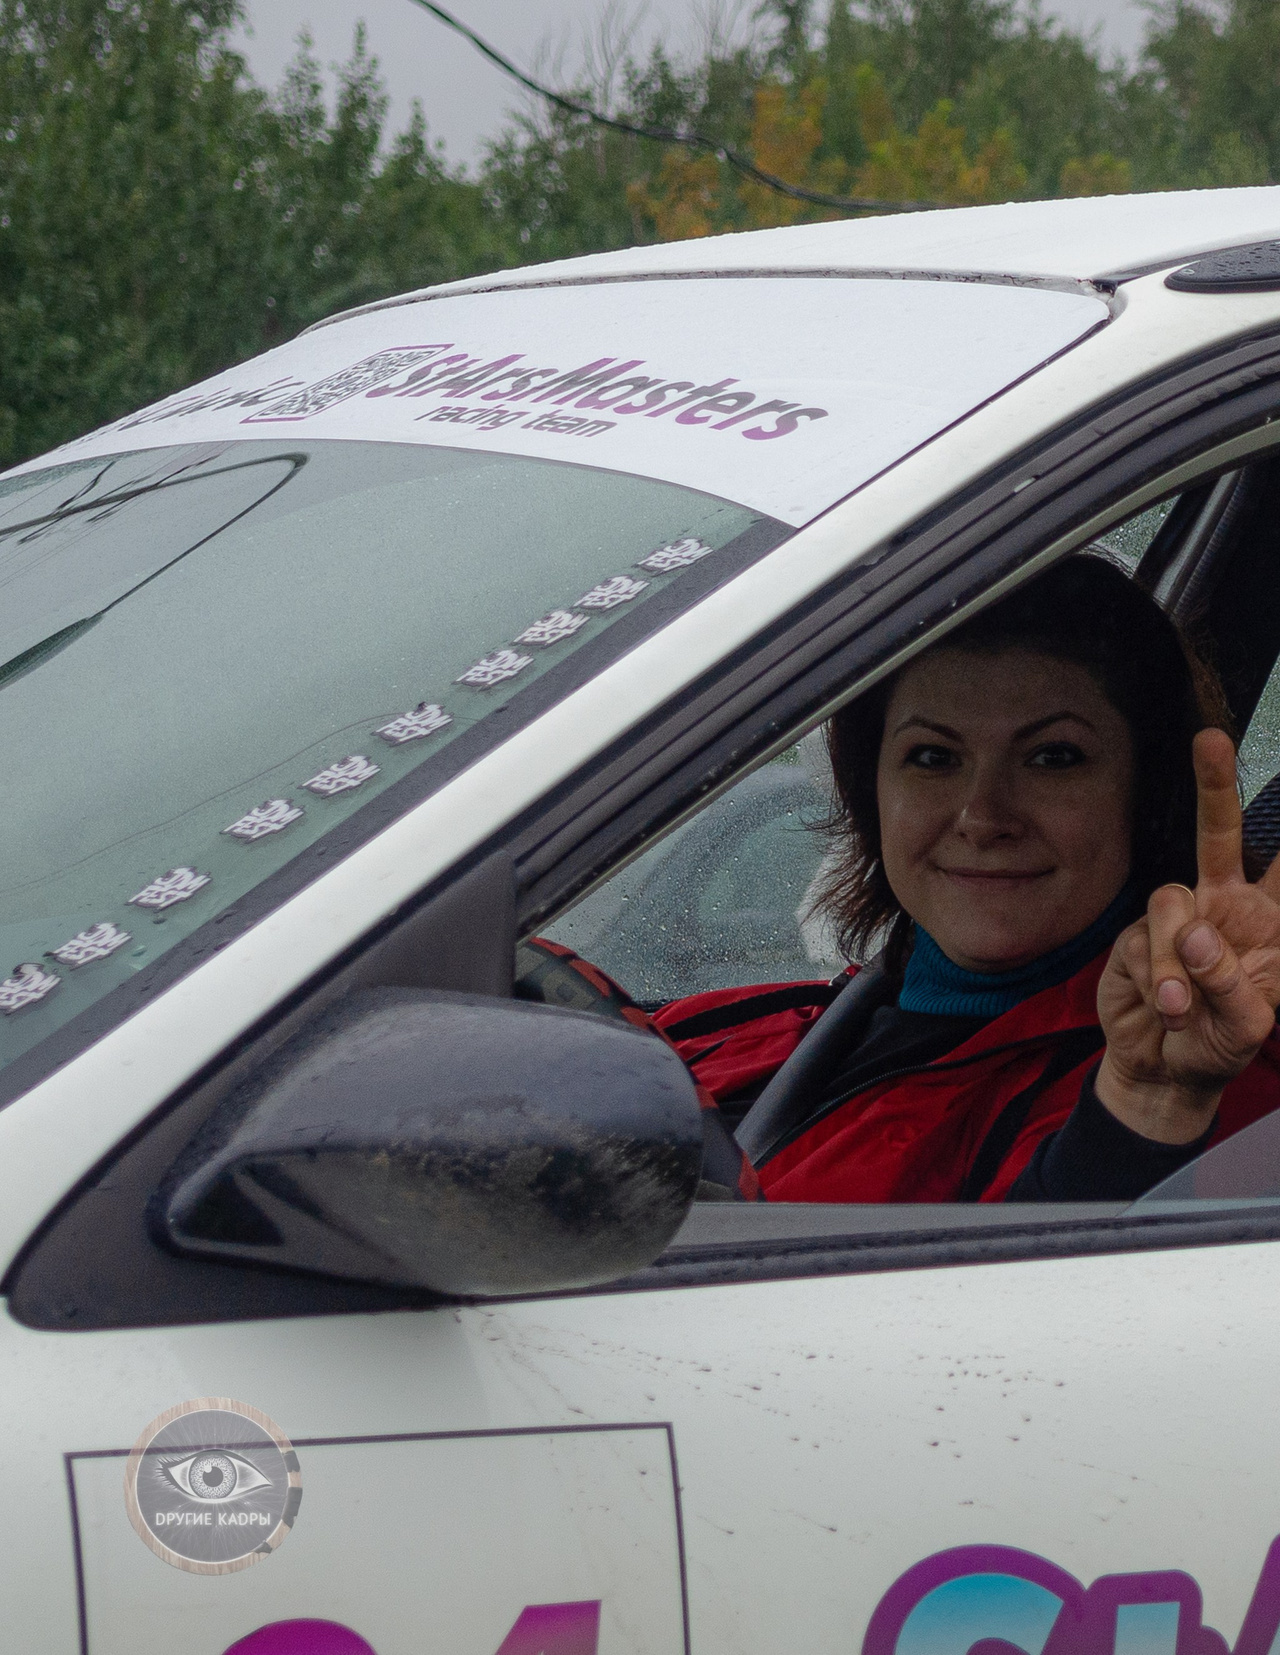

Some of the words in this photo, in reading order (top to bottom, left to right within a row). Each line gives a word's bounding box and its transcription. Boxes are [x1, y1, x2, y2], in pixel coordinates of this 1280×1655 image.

[365, 353, 829, 441] StArsMasters
[414, 404, 529, 431] racing
[521, 409, 618, 438] team
